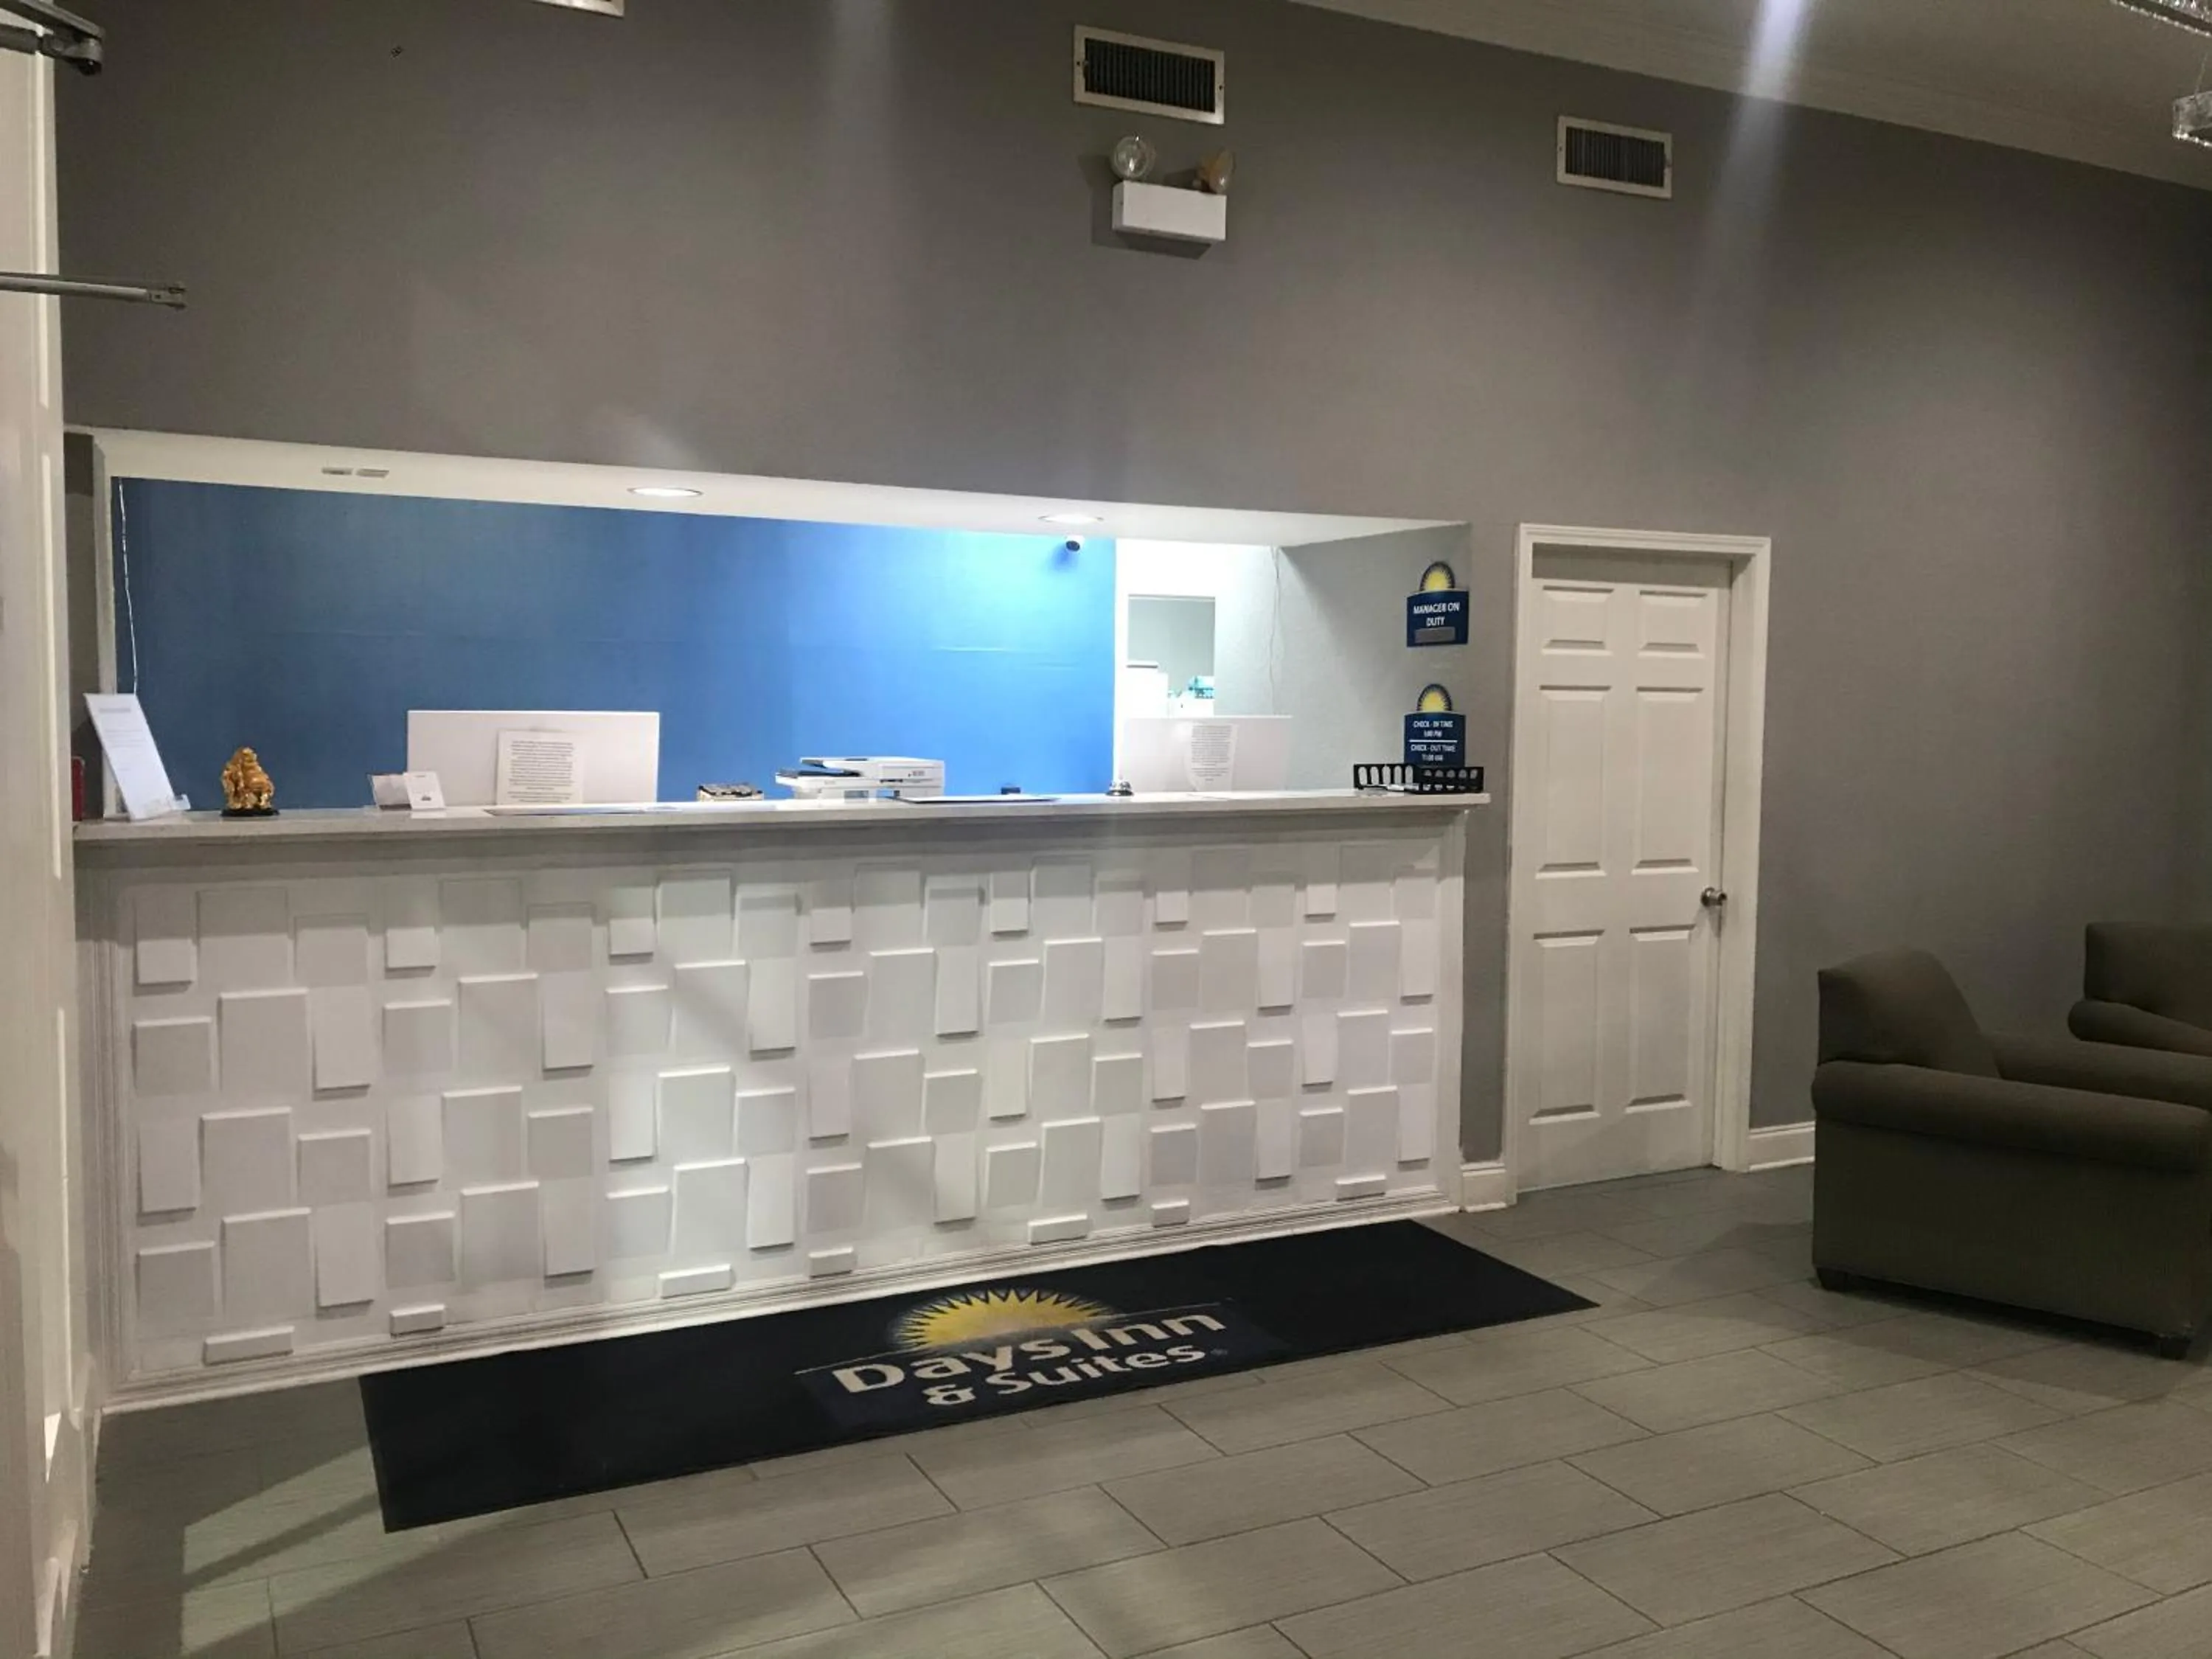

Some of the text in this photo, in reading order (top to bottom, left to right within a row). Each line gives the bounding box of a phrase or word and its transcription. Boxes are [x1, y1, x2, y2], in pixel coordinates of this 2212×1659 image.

[1413, 601, 1461, 614] MANAGER ON
[1426, 616, 1445, 627] DUTY
[832, 1315, 1227, 1393] Days Inn
[922, 1345, 1206, 1405] & Suites
